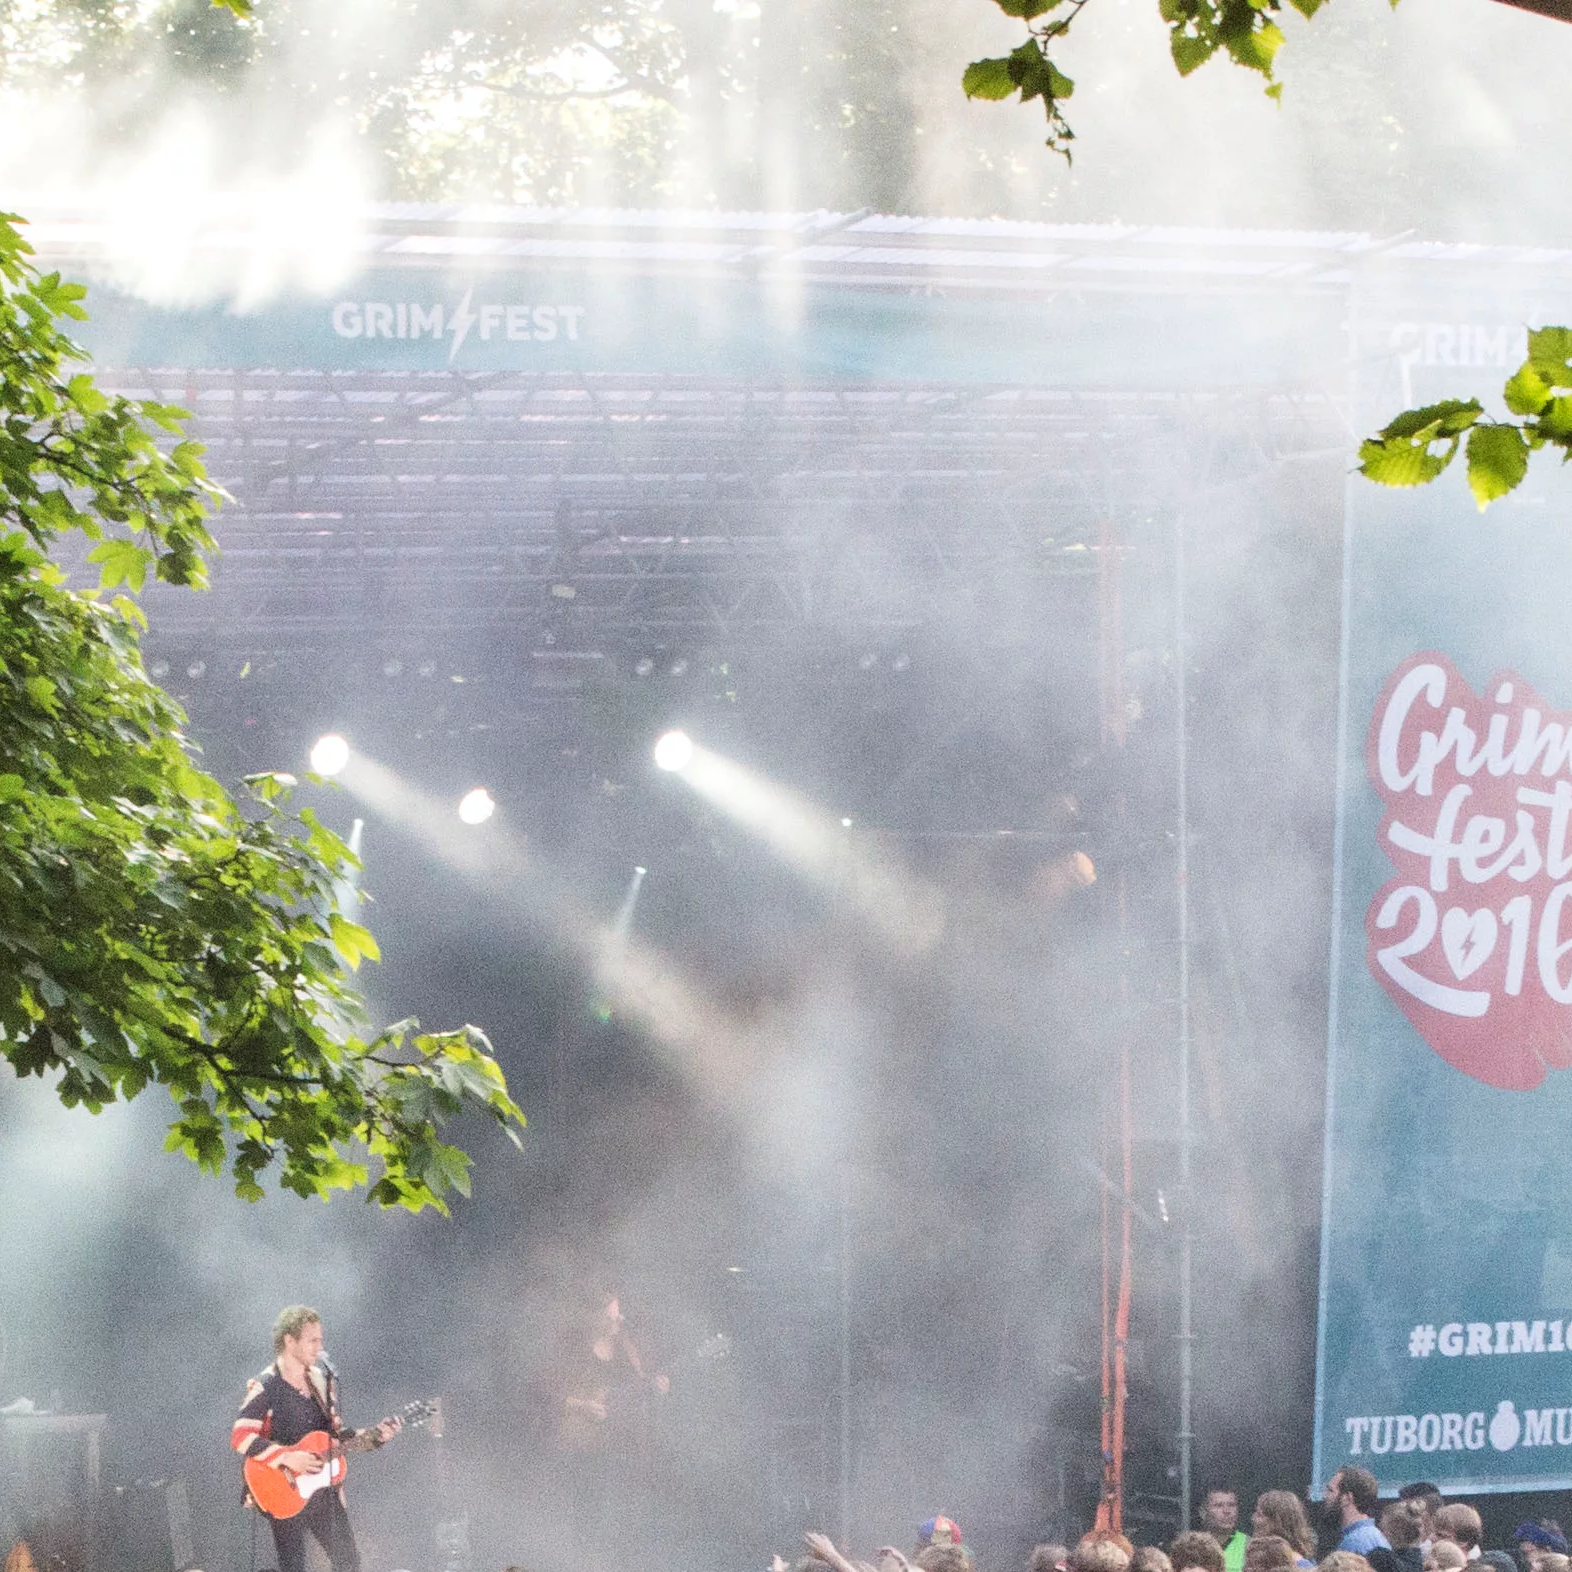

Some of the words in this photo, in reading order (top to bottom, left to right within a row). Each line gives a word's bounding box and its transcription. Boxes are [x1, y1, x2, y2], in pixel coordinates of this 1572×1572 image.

[332, 301, 443, 339] GRIM
[479, 304, 586, 342] FEST
[1345, 1411, 1486, 1455] TUBORG
